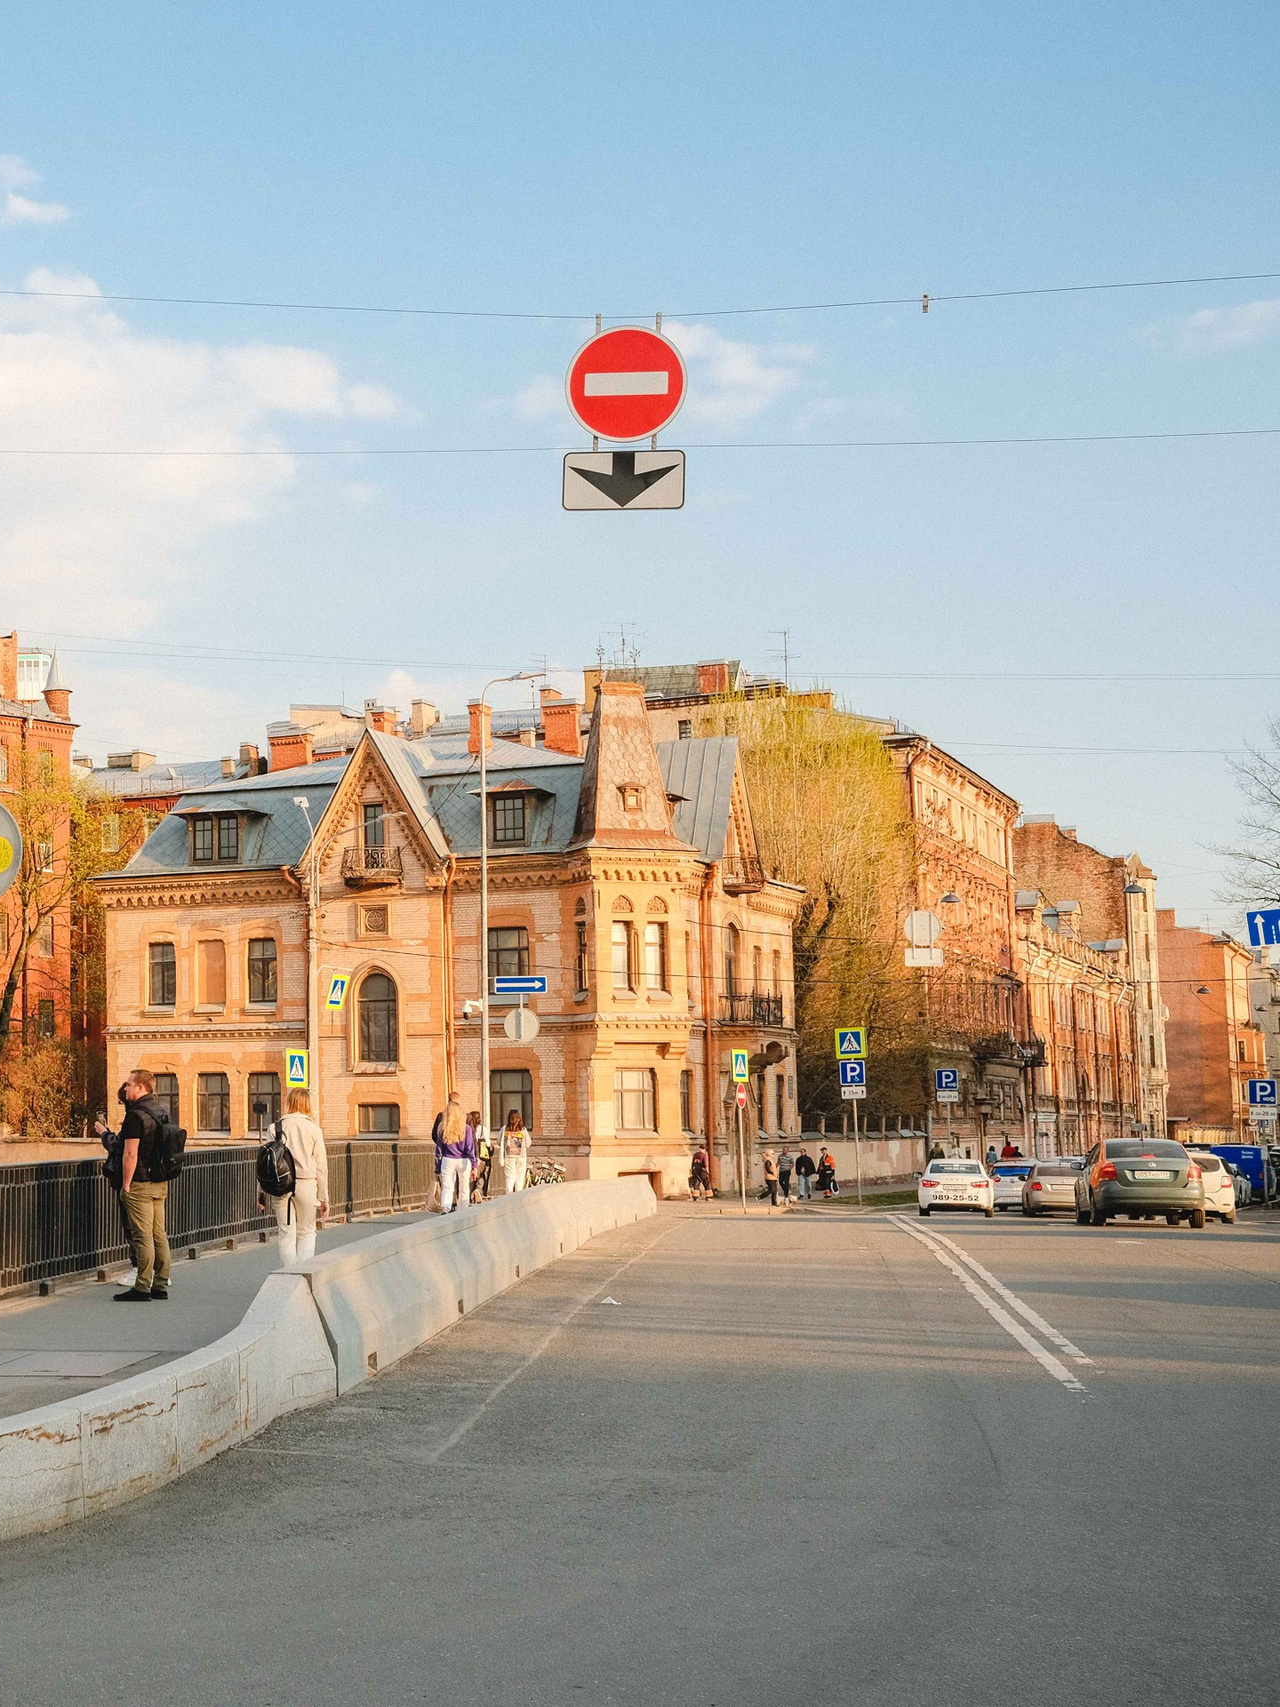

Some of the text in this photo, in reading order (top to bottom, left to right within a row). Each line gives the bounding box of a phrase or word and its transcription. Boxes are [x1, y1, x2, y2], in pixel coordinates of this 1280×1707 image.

[846, 1063, 860, 1082] P
[942, 1071, 954, 1087] P
[1256, 1082, 1271, 1102] P
[932, 1194, 979, 1202] 989-25-52
